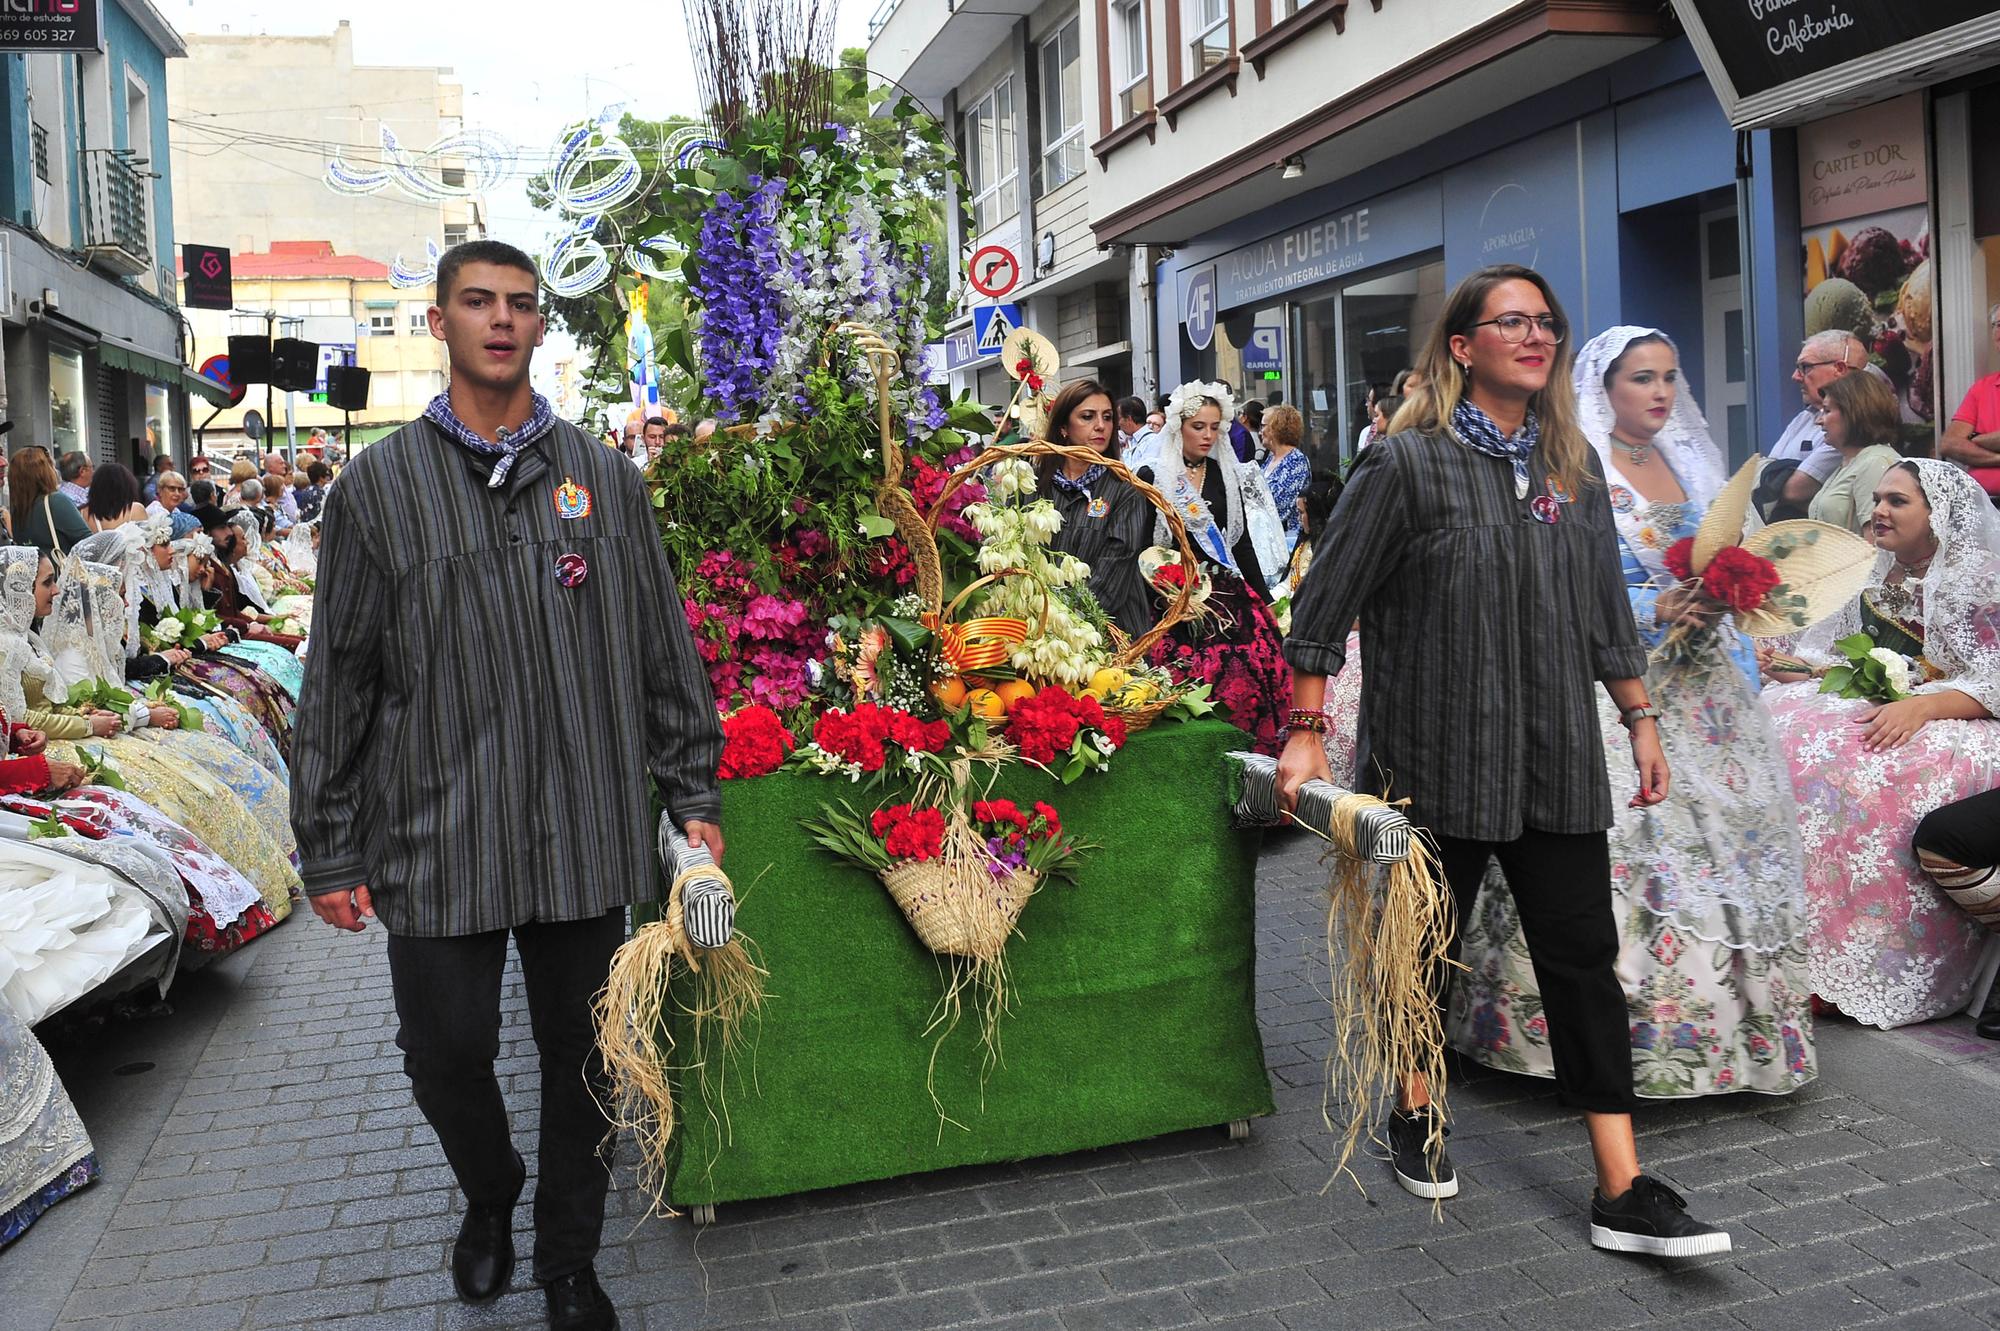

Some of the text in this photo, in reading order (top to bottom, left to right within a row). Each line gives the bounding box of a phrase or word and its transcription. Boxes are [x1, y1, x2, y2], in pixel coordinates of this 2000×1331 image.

[19, 14, 31, 22] de
[33, 14, 72, 23] estudios
[24, 30, 47, 41] 605
[51, 30, 76, 42] 327
[1767, 5, 1854, 55] Cafetería
[1813, 144, 1908, 181] CARTE D'OR
[1230, 208, 1370, 285] AQUA FUERTE
[1482, 226, 1536, 253] APORAGUA
[1236, 252, 1365, 302] TRATAMIENTO INTEGRAL DE AGUA
[1187, 282, 1211, 331] AF
